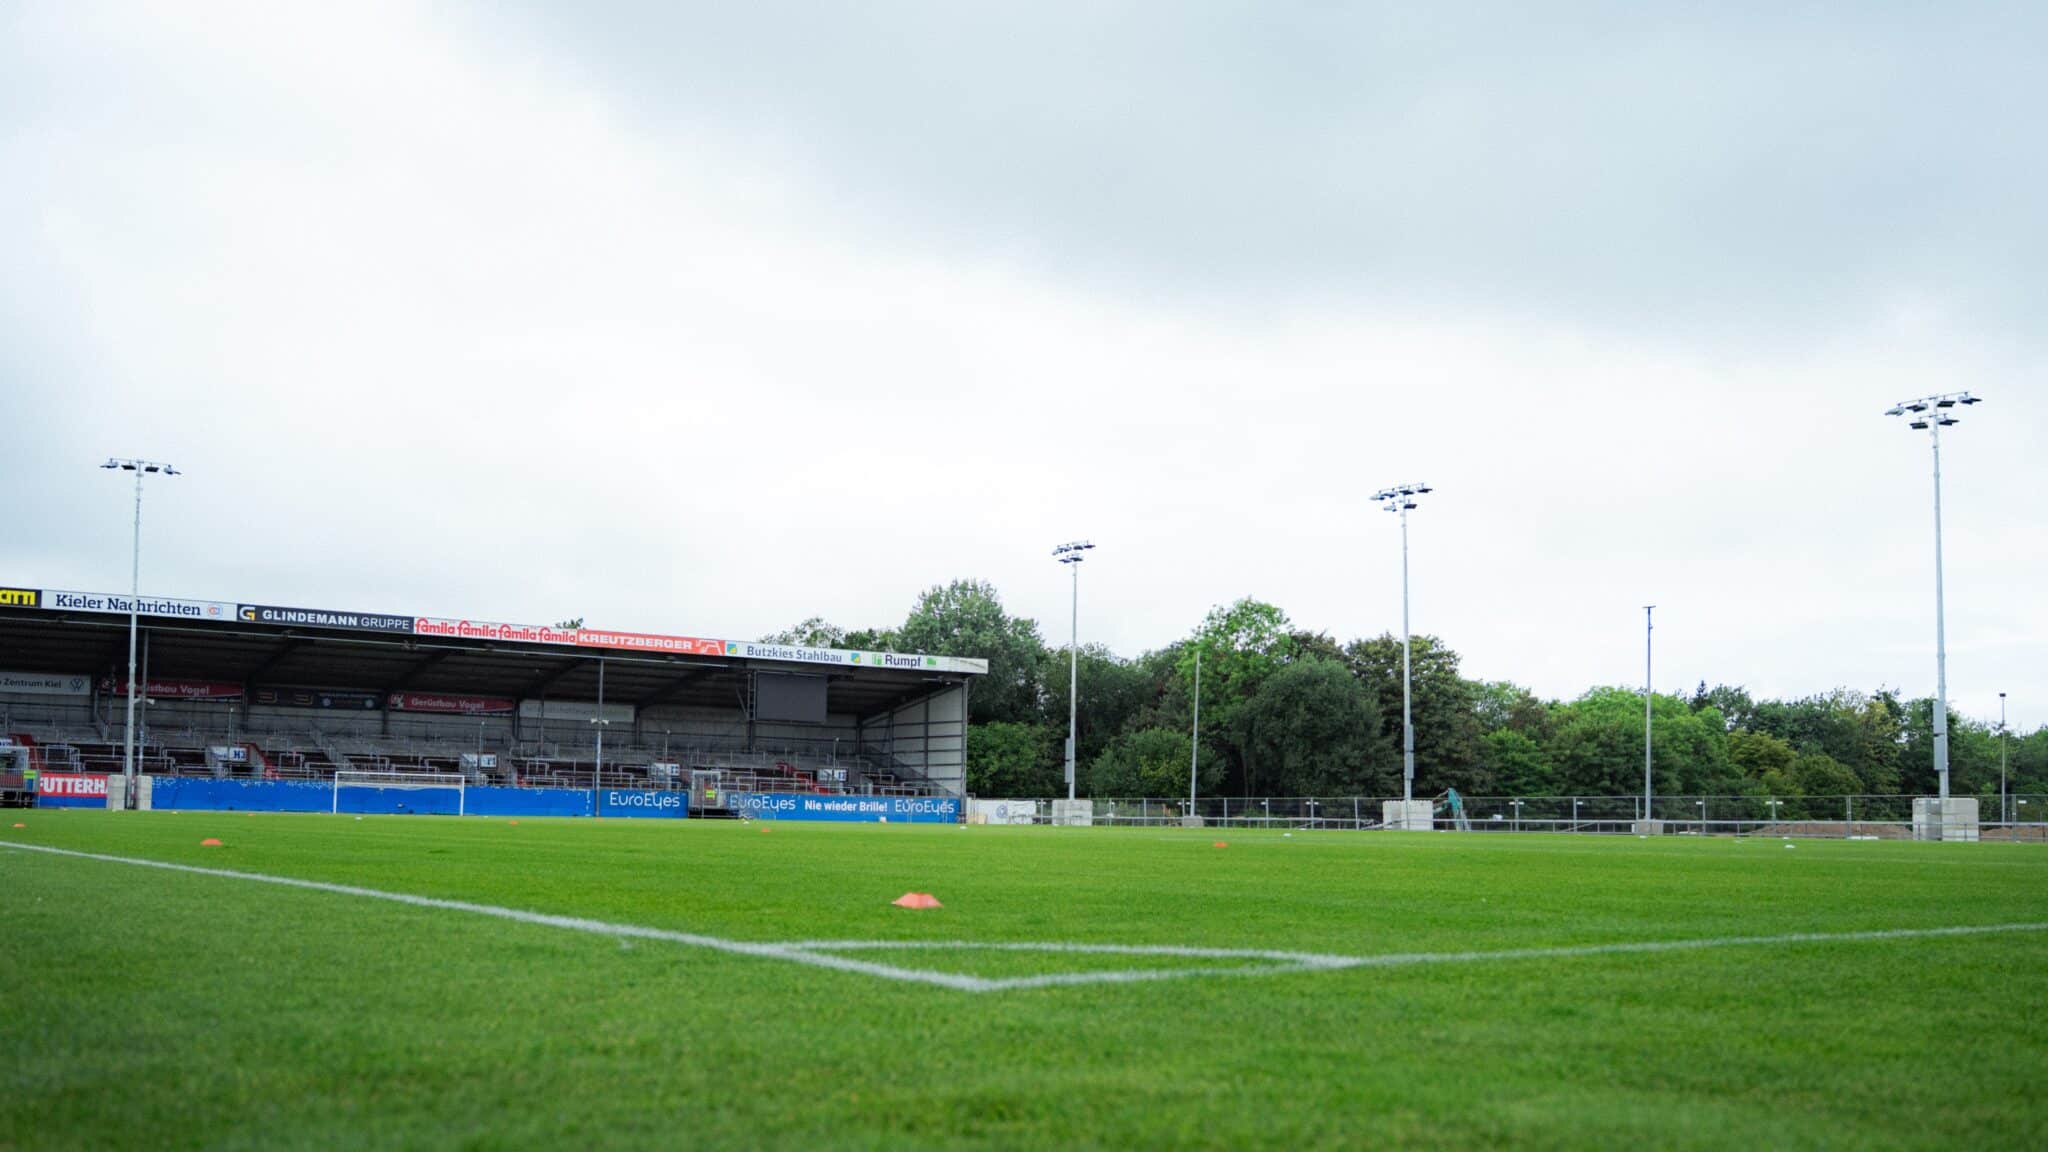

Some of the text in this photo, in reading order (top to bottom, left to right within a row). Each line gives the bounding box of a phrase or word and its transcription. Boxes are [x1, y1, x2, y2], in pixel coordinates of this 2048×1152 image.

[56, 594, 201, 616] Kieler Nachrichten
[262, 609, 410, 630] GLINDEMANN GRUPPE
[415, 618, 455, 635] famila
[457, 620, 496, 638] famila
[498, 624, 537, 641] famila
[538, 627, 576, 643] famila
[579, 633, 693, 650] KREUTZBERGER
[747, 645, 842, 663] Butzkies Stahlbau
[885, 654, 922, 668] Rumpf
[180, 684, 210, 697] Vogel
[411, 698, 486, 711] Gerüstbau Vogel
[40, 776, 108, 794] UTTERH
[609, 791, 681, 809] EuroEyes
[730, 795, 796, 812] EuroEyes
[804, 799, 888, 812] Nie wieder Brille!
[895, 799, 955, 815] EuroEyes
